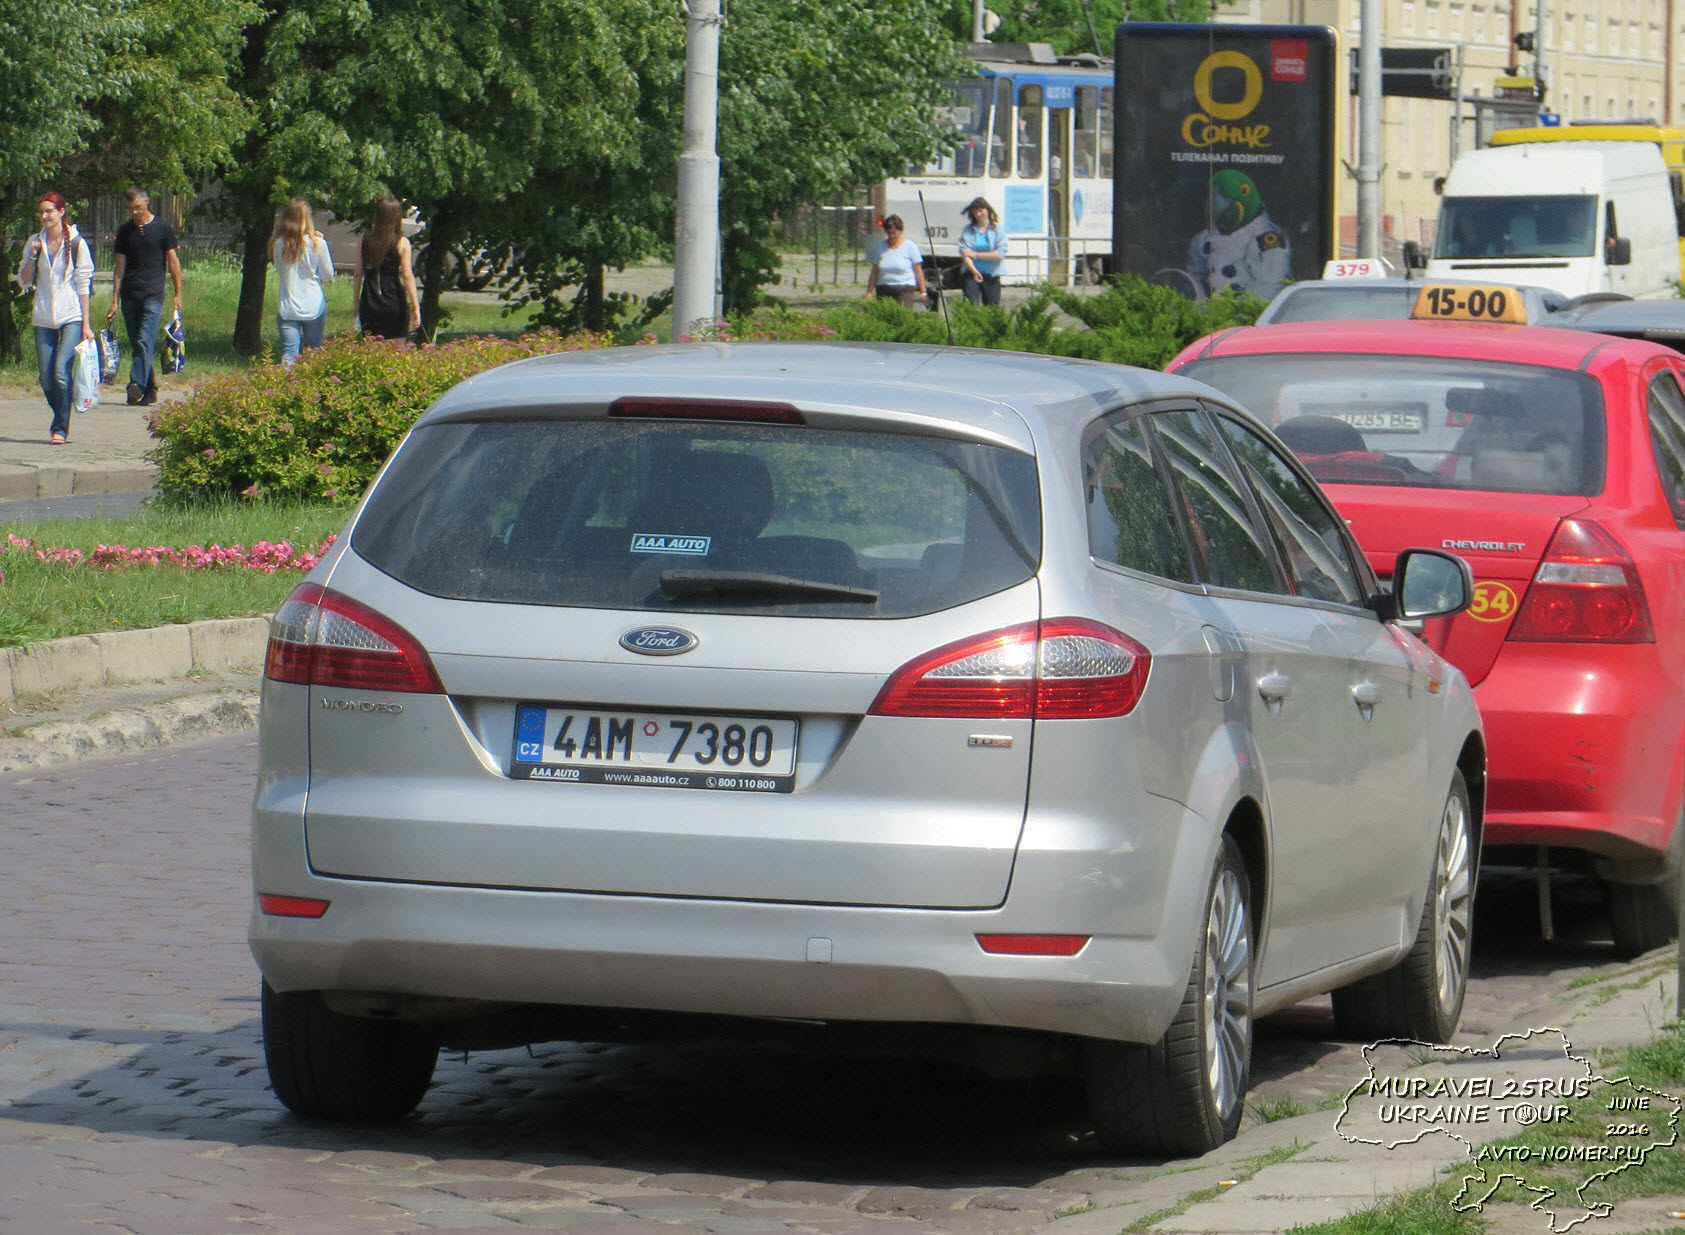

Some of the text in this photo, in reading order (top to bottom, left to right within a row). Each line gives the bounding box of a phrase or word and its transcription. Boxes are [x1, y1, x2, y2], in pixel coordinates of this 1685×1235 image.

[1181, 112, 1273, 148] Сонце
[1171, 152, 1285, 164] ТЕЛЕКАНАЛ ПОЗИТИВУ
[1336, 263, 1370, 277] 379
[1427, 287, 1506, 318] 15-00
[635, 536, 706, 550] AAA AUTO
[1441, 539, 1525, 552] CHEVROLET
[1471, 588, 1510, 614] 54
[635, 630, 680, 647] Ford
[321, 698, 404, 714] MONDEO
[554, 714, 774, 767] 4AM 7380
[520, 742, 540, 757] CZ
[530, 767, 580, 779] AAA AUTO
[604, 772, 690, 785] www.aaaauto.cz
[718, 777, 737, 788] 800
